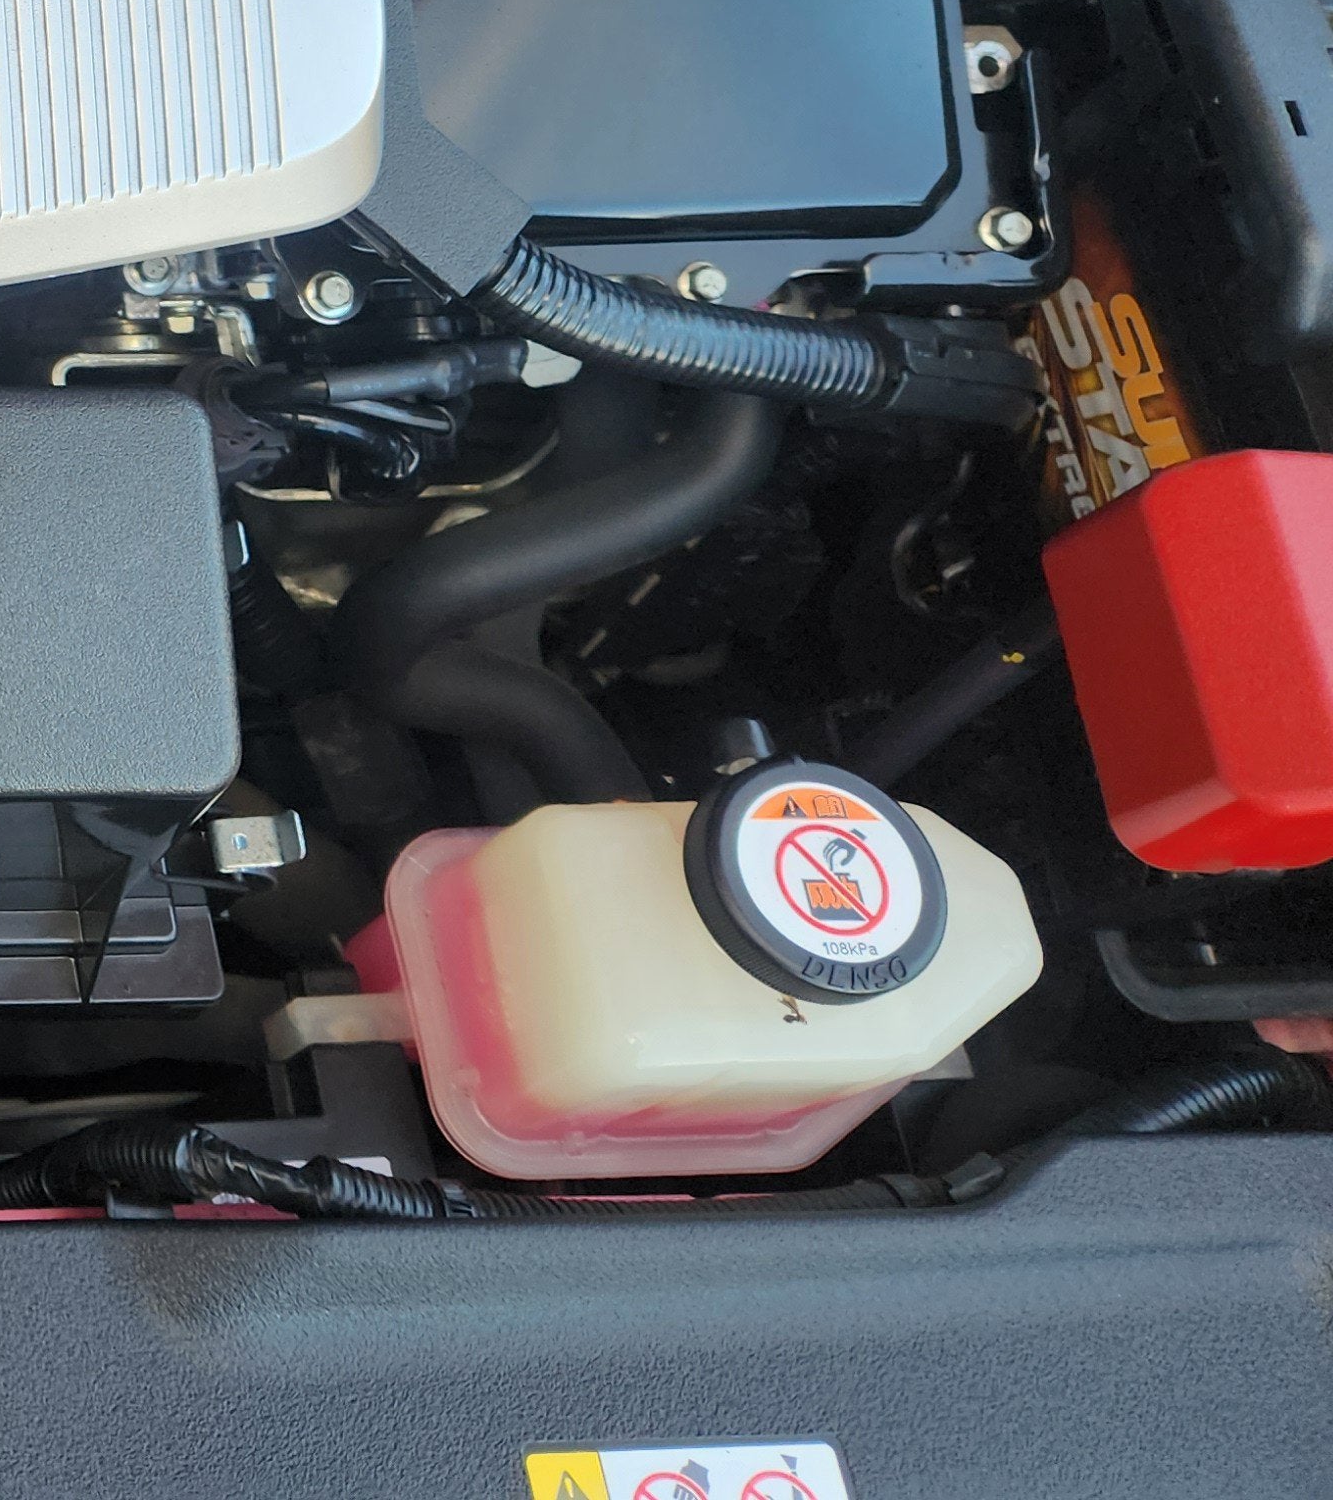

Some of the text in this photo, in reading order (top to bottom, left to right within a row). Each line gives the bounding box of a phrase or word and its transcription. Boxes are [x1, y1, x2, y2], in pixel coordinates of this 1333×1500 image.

[1095, 293, 1191, 470] SU
[822, 941, 879, 957] 108kPa
[801, 955, 909, 990] DENSO
